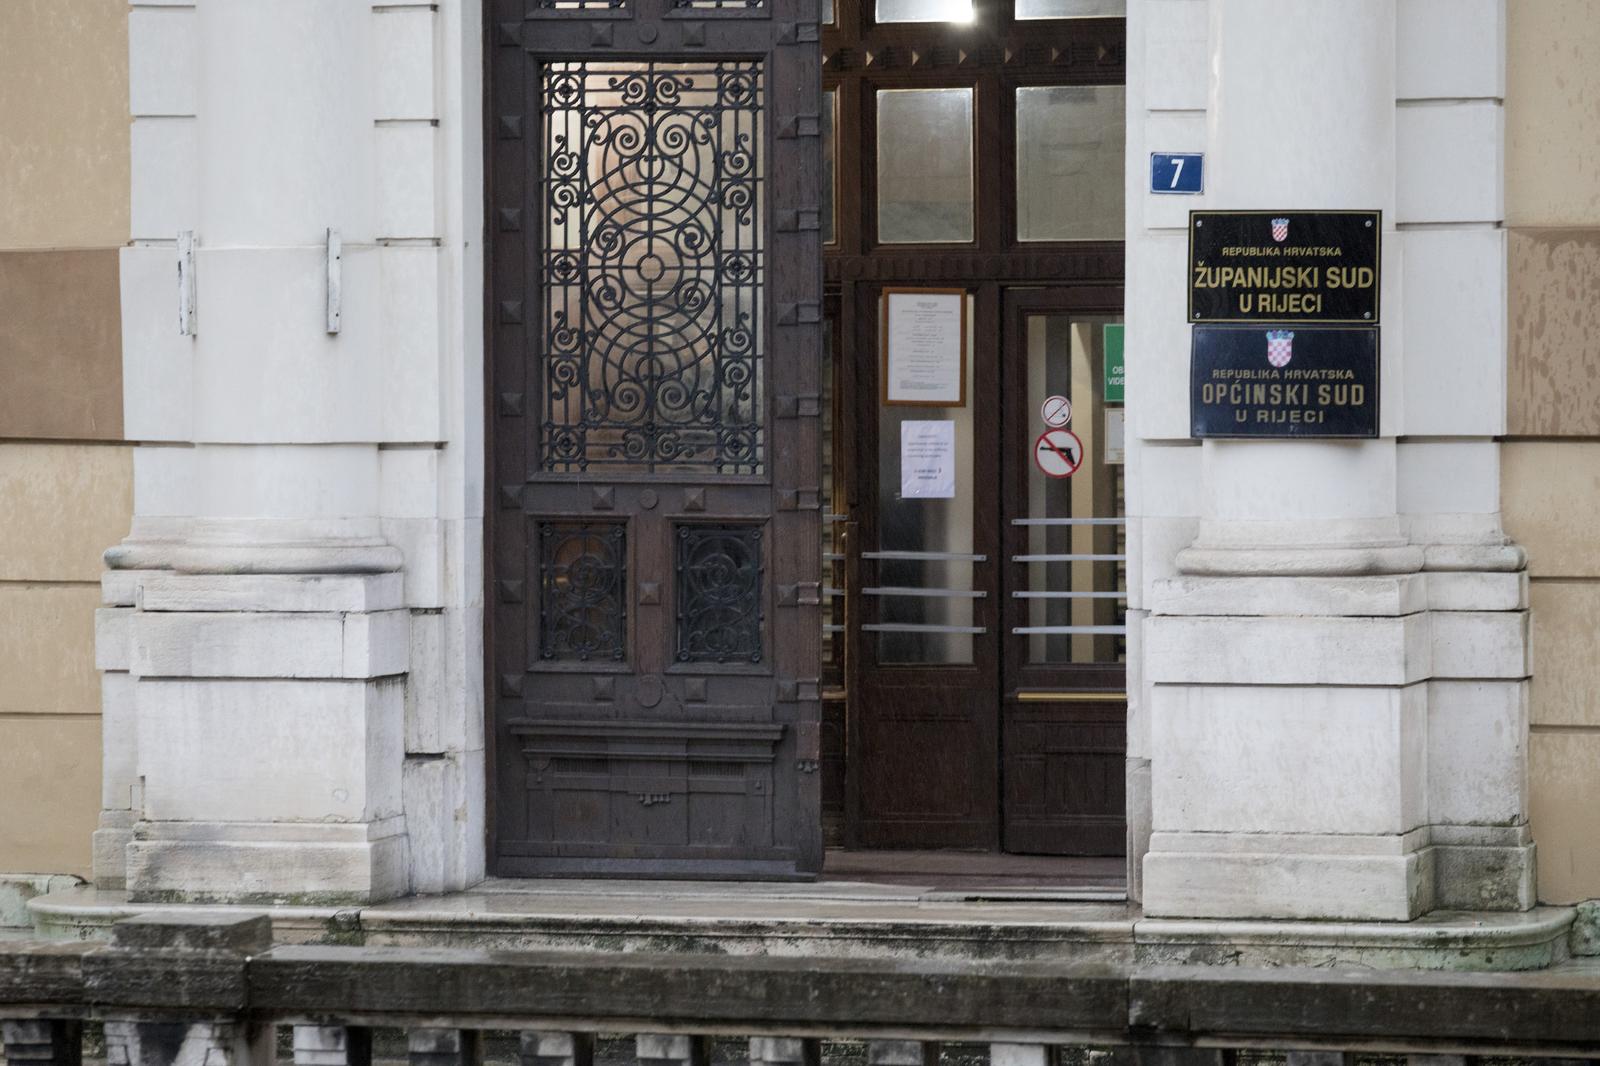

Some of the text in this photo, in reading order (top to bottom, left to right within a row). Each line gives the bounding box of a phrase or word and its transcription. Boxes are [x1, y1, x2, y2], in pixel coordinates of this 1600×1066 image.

[1170, 158, 1185, 189] 7
[1222, 247, 1342, 256] REPUBLIKA HRVATSKA
[1194, 260, 1374, 289] ŽUPANIJSKI SUD
[1239, 294, 1322, 314] U RIJECI
[1212, 369, 1354, 380] REPUBLIKA HRVATSKA
[1202, 380, 1365, 405] OPĆINSKI SUD
[1235, 410, 1325, 424] U RIJECI
